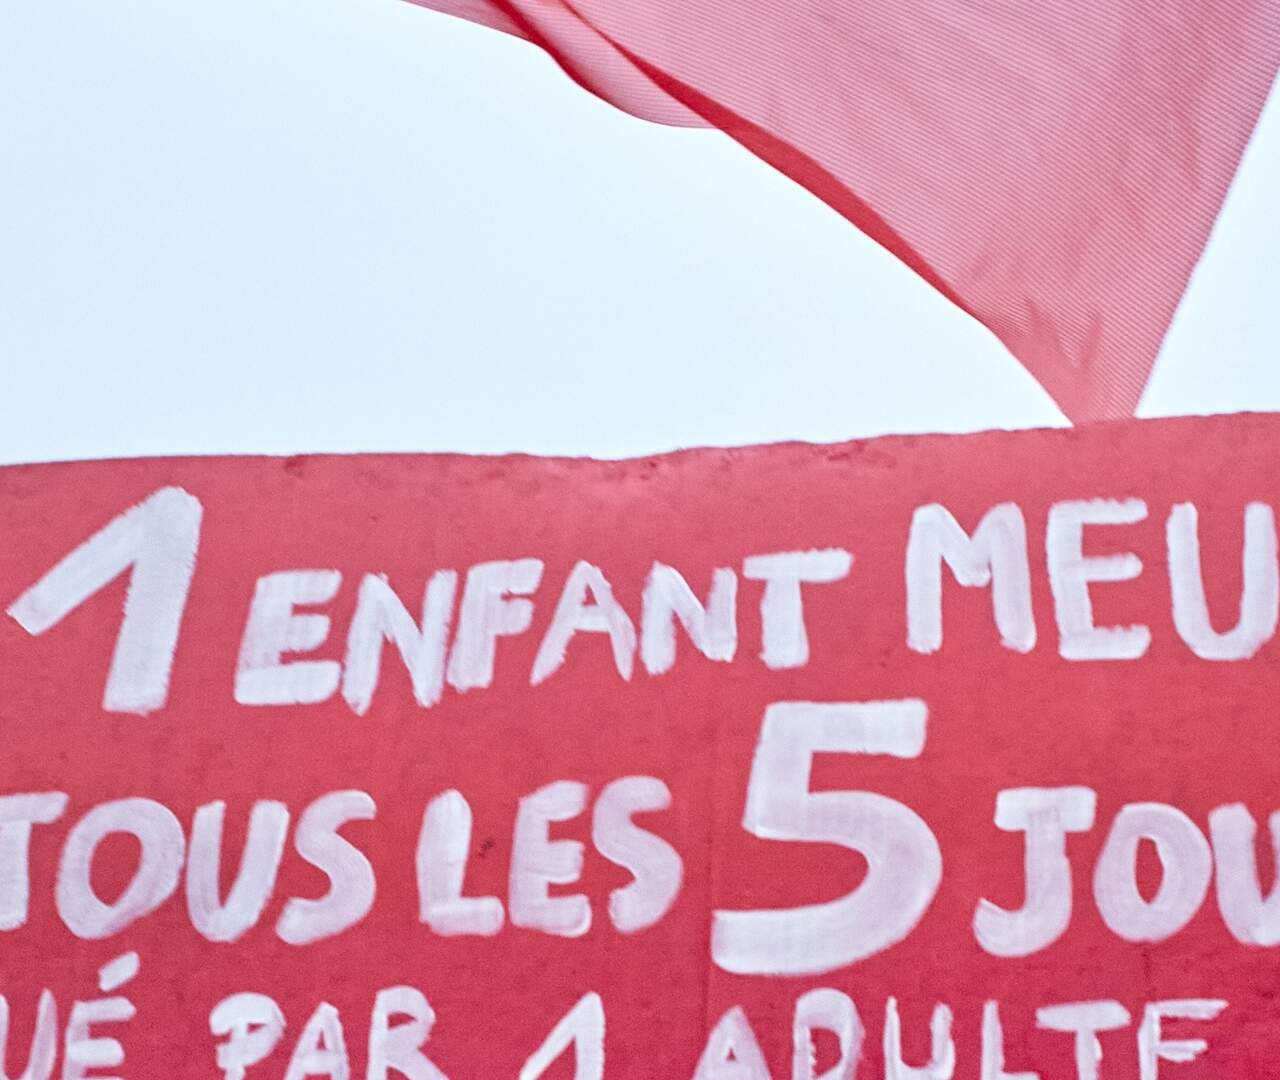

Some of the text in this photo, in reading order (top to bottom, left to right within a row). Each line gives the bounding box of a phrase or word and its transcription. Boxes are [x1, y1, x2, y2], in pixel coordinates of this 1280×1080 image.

[6, 486, 204, 715] 1
[233, 548, 853, 715] ENFANT
[416, 775, 683, 938] LES
[711, 697, 943, 975] 5
